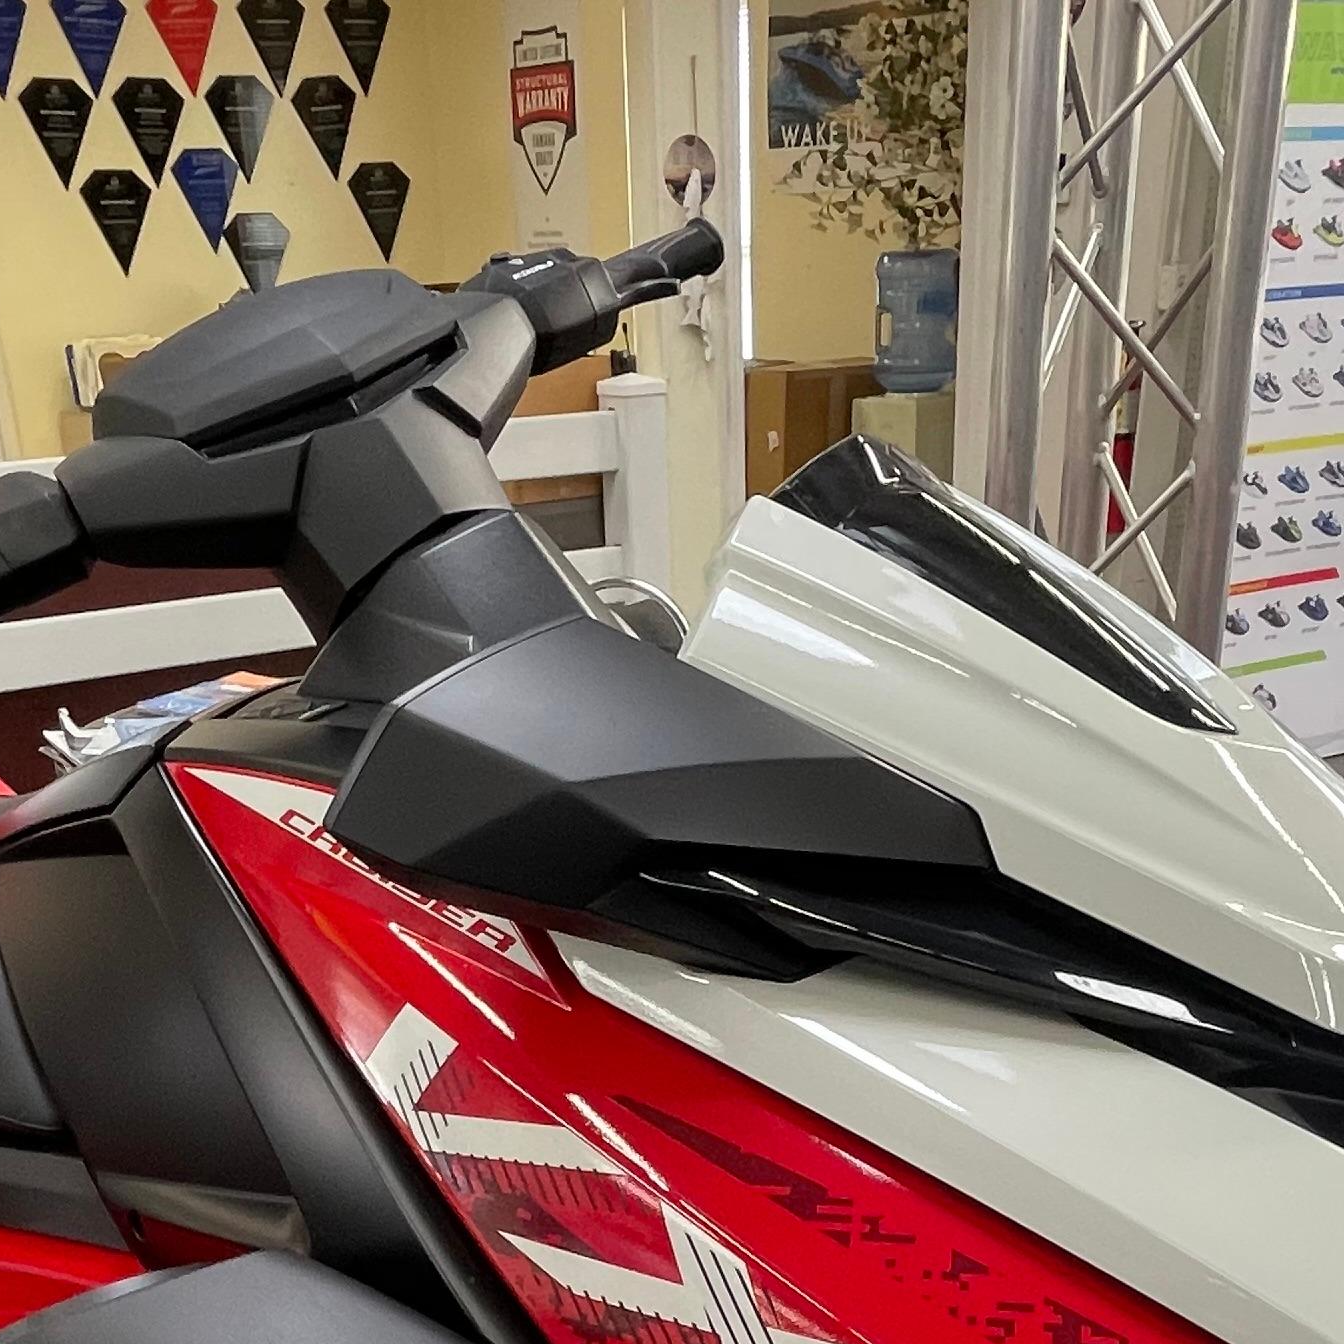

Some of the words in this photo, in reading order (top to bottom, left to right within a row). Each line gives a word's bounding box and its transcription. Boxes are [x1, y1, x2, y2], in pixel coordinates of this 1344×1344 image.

[515, 86, 569, 118] WARRANTY
[780, 120, 840, 149] WAKE
[278, 808, 518, 953] CRER
